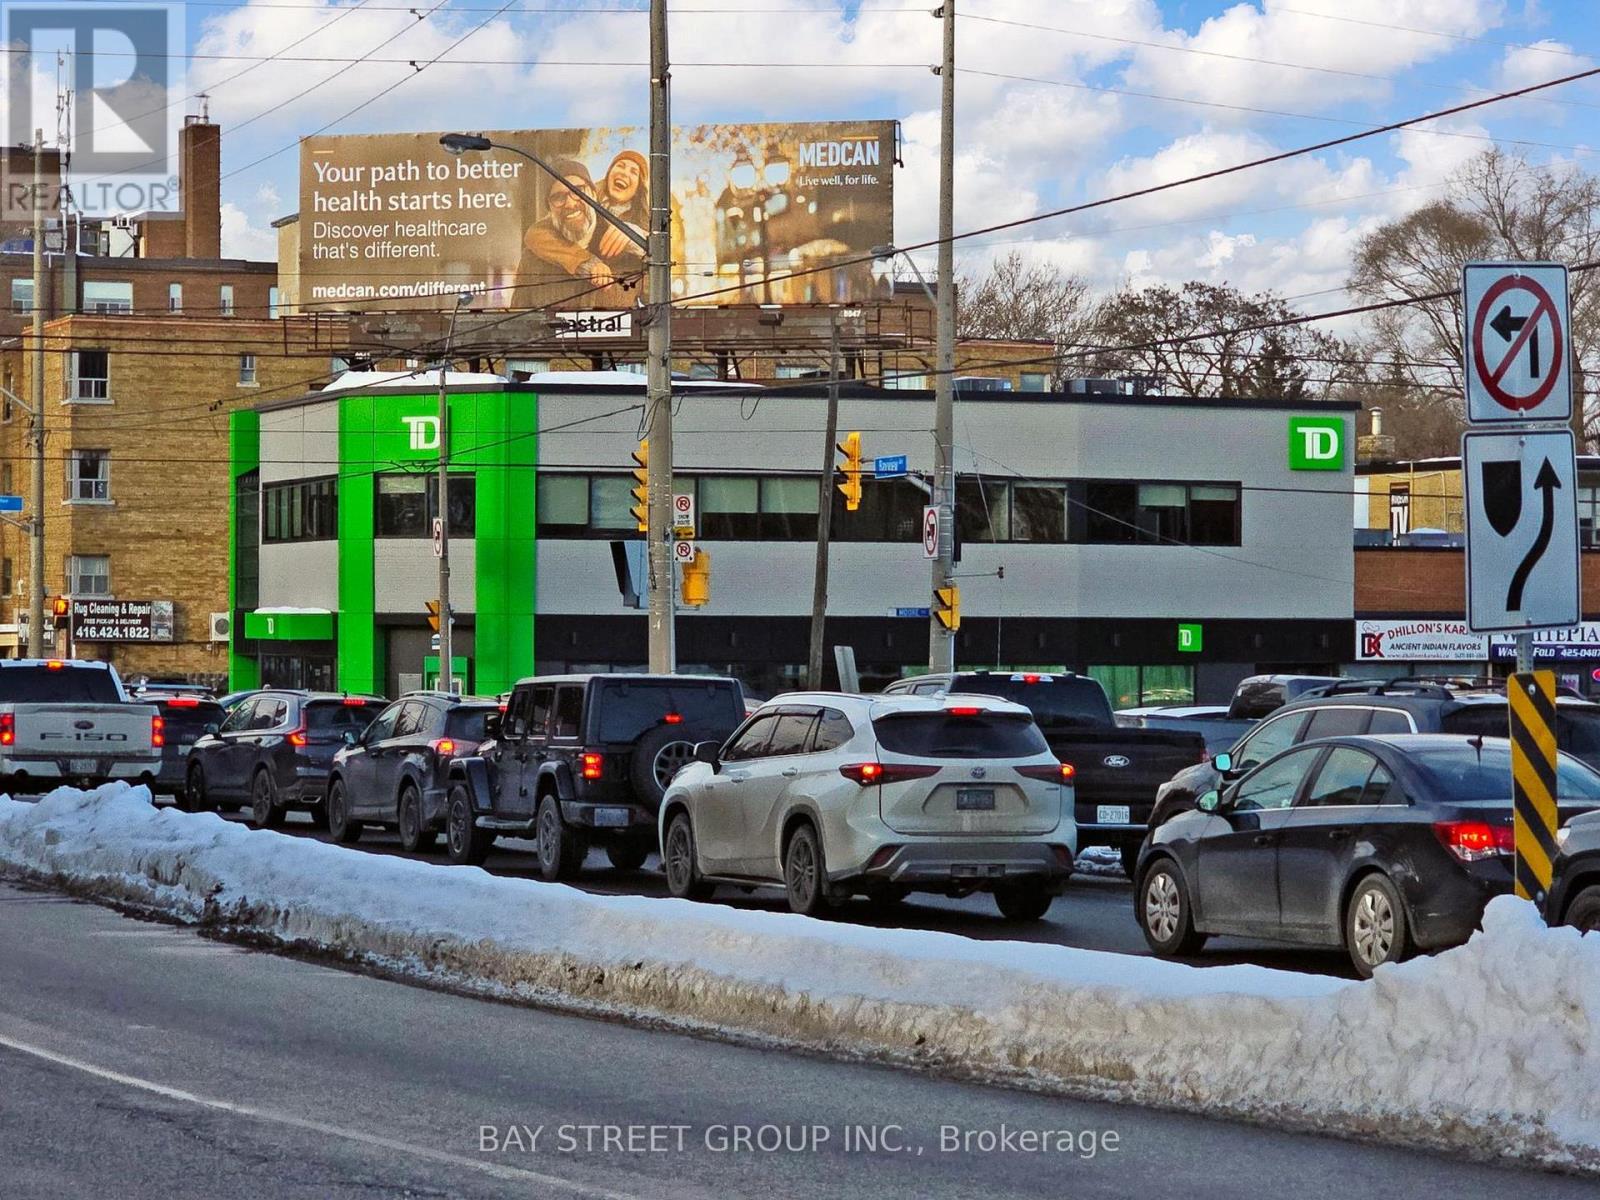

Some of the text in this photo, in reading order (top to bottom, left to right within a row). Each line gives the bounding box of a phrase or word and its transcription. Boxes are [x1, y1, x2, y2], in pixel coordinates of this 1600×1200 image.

[799, 141, 880, 167] MEDCAN
[313, 158, 523, 187] Your path to better
[800, 173, 880, 187] Live well, for life.
[314, 188, 512, 212] health starts here.
[314, 219, 488, 239] Discover healthcare
[313, 240, 440, 260] that's different.
[312, 280, 487, 298] medcan.com/different
[401, 415, 441, 450] TD
[1297, 426, 1339, 459] TD
[74, 602, 151, 617] Rug Cleaning & Repair
[76, 626, 150, 638] 416.424.1822
[1179, 630, 1191, 646] TD
[1387, 623, 1442, 640] DHILLON'S
[1390, 643, 1481, 651] ANCIENT INDIAN FLAVORS
[40, 732, 128, 741] F-150
